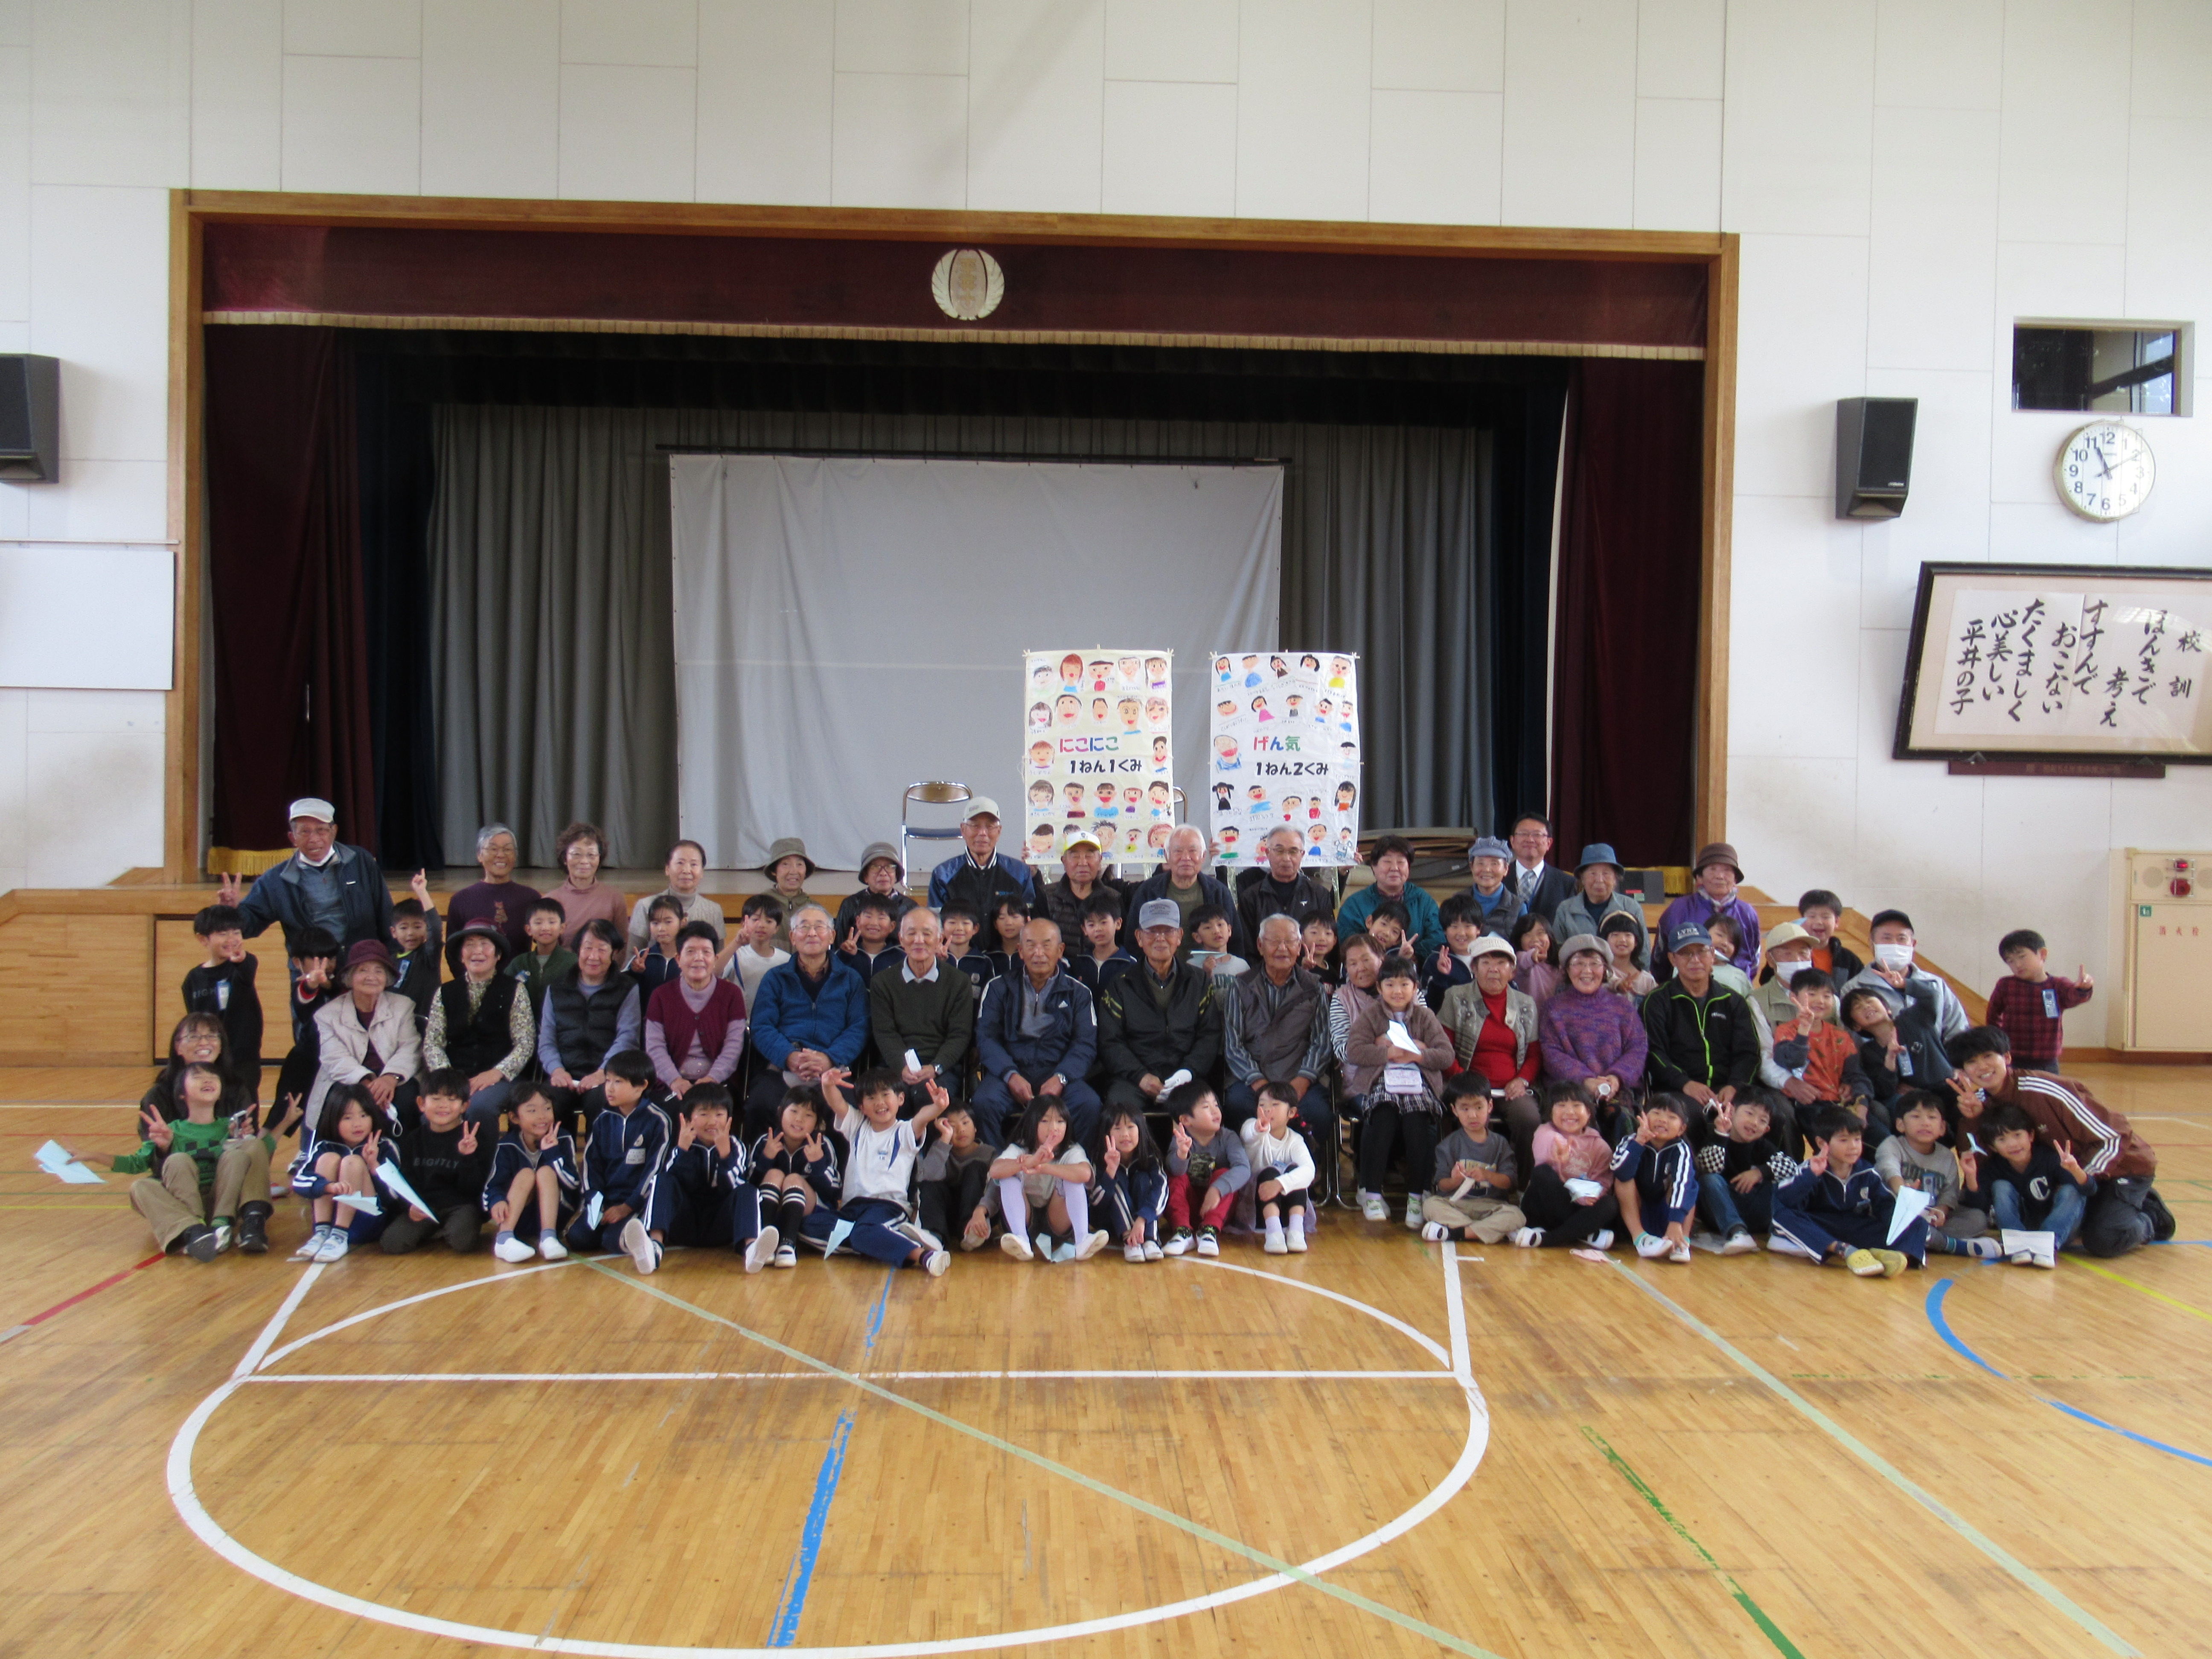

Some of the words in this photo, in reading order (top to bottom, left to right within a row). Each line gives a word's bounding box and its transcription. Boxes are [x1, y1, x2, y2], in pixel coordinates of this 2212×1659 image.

[2085, 436, 2097, 448] 11
[2100, 431, 2115, 444] 12
[2124, 438, 2127, 450] 1
[2072, 449, 2088, 461] 10
[2132, 449, 2140, 461] 2
[2069, 464, 2078, 477] 9
[2136, 466, 2145, 479] 3
[2074, 481, 2083, 493] 8
[2130, 483, 2138, 495] 4
[2087, 493, 2096, 506] 7
[2101, 498, 2110, 510] 6
[2119, 494, 2127, 506] 5
[2072, 599, 2109, 695] すすんで
[1982, 609, 2018, 701] 心美しい
[2008, 598, 2046, 722] たくましく
[2131, 610, 2168, 704] ほんきで
[1949, 619, 1986, 715] 平井の子
[2042, 621, 2077, 714] おこない
[2168, 630, 2202, 699] 校訓
[2099, 666, 2129, 727] 考え
[1059, 736, 1119, 753] にこにこ
[1253, 736, 1301, 751] げん気
[1070, 759, 1142, 774] 1ねん1くみ
[1257, 762, 1329, 776] 1ねん2くみ
